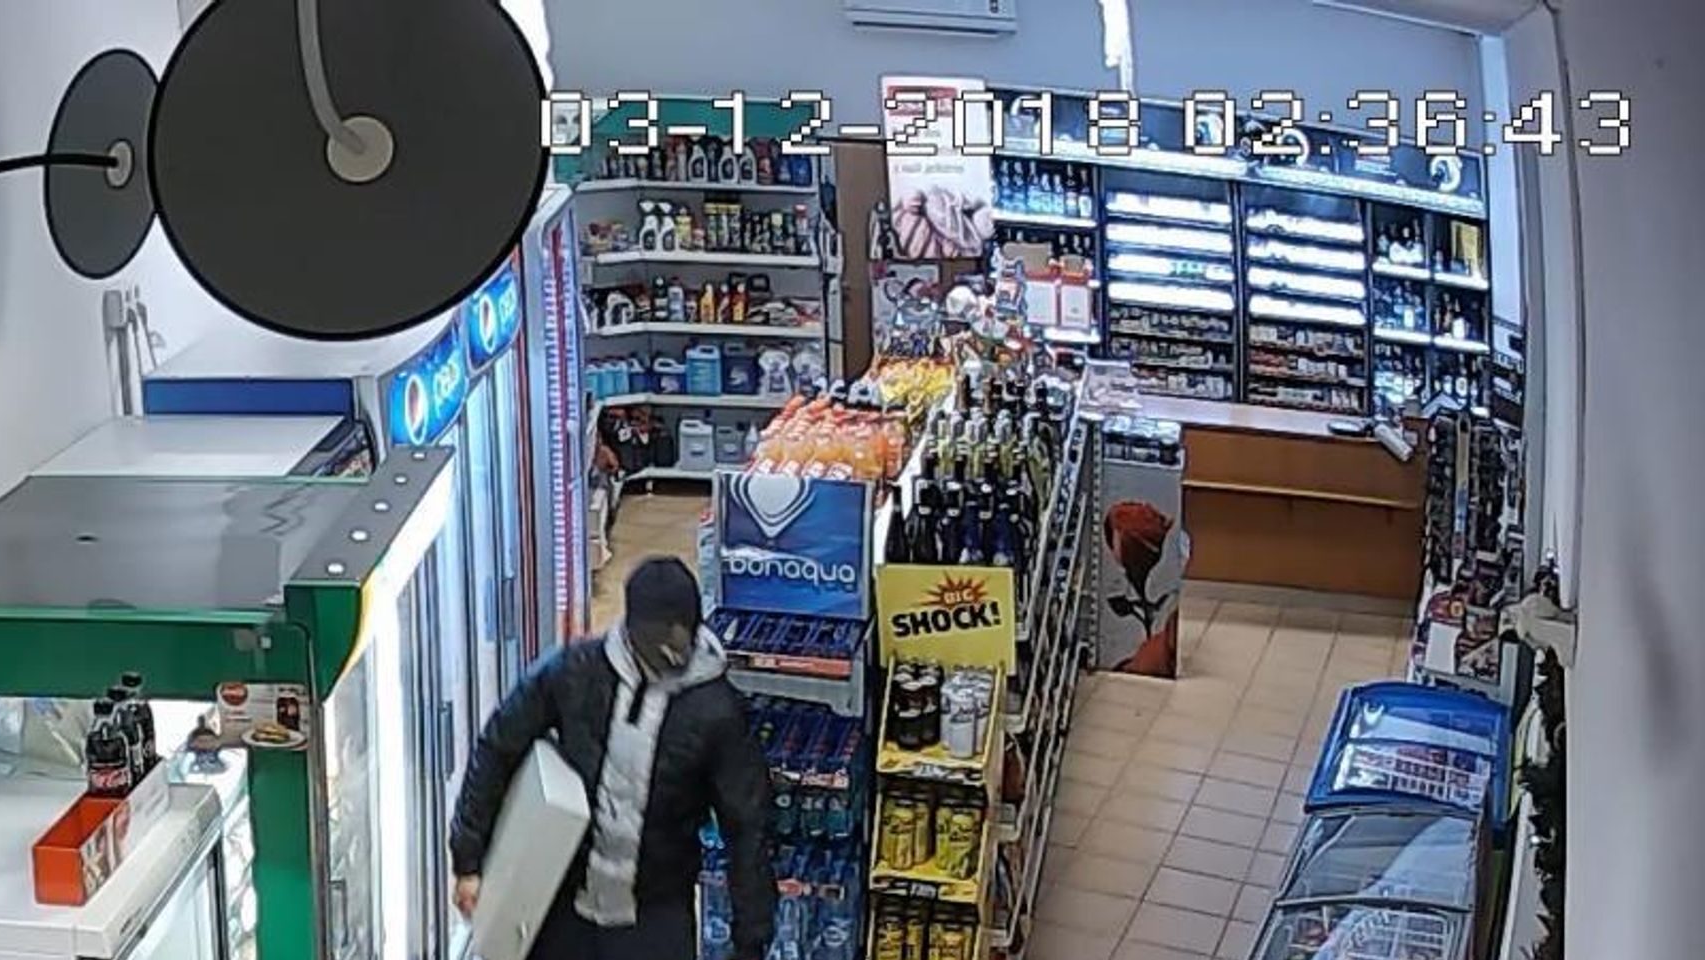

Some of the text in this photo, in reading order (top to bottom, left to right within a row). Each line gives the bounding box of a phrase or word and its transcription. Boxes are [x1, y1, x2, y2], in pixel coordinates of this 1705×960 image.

[728, 556, 856, 586] bonaqua
[943, 588, 974, 604] BIG
[891, 601, 1001, 637] SHOCK!
